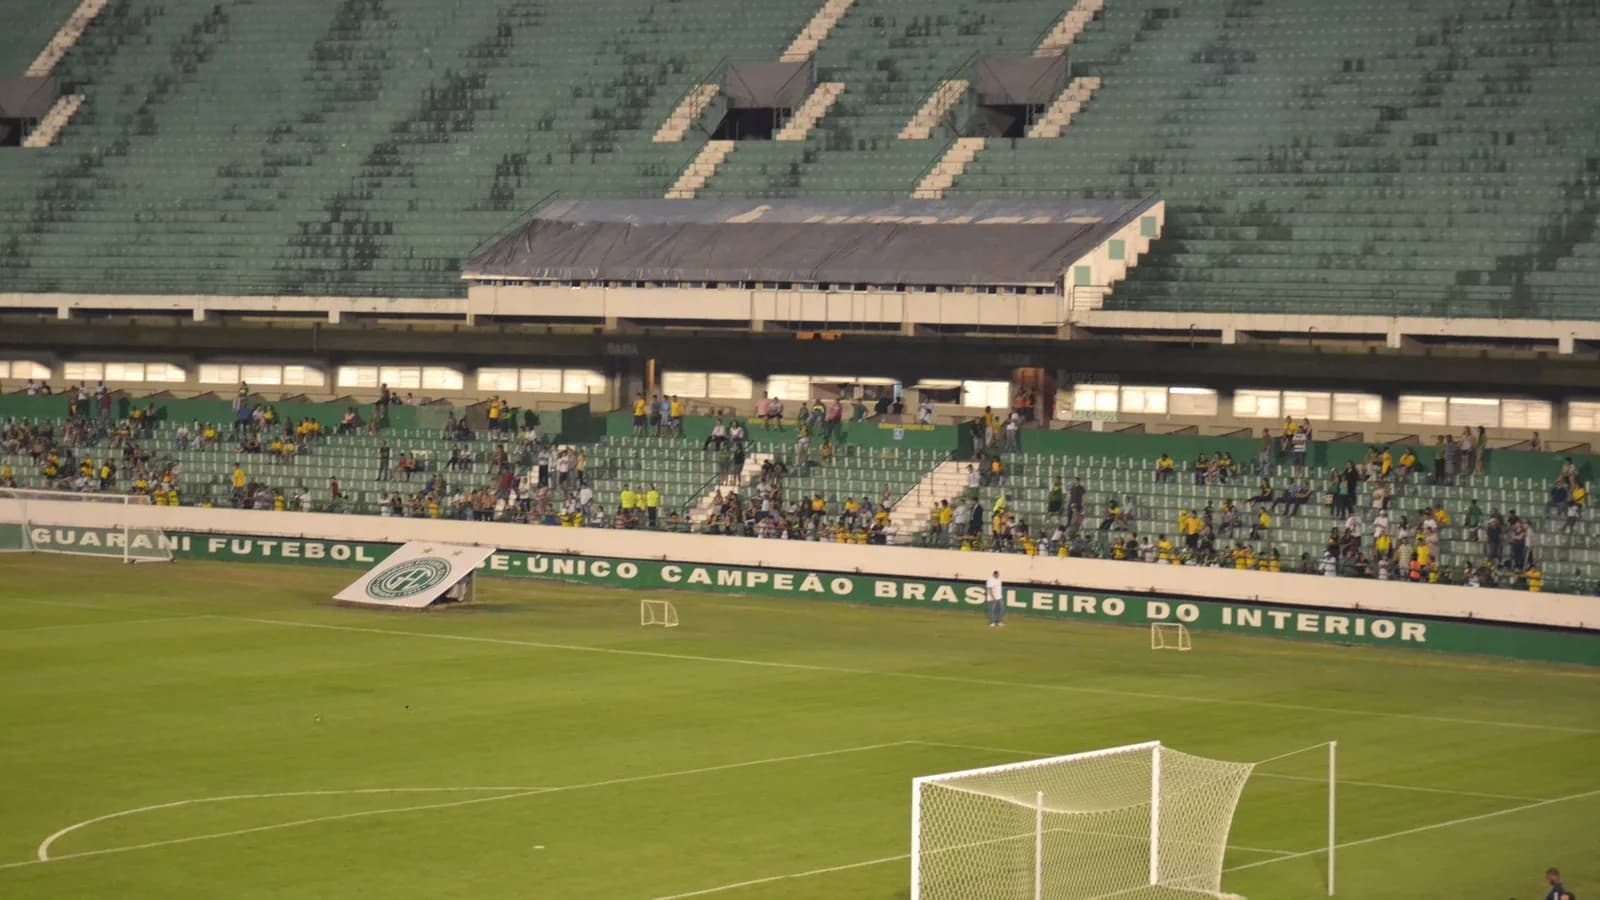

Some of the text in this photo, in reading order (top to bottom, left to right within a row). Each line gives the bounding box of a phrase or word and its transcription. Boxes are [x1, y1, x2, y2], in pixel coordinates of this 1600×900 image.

[31, 528, 191, 551] GUARANI
[208, 538, 374, 562] FUTEBOL
[661, 565, 854, 595] CAMPEÃO
[874, 580, 1126, 617] BRASLEIRO
[1146, 602, 1199, 622] DO
[1222, 607, 1427, 642] INTERIOR
